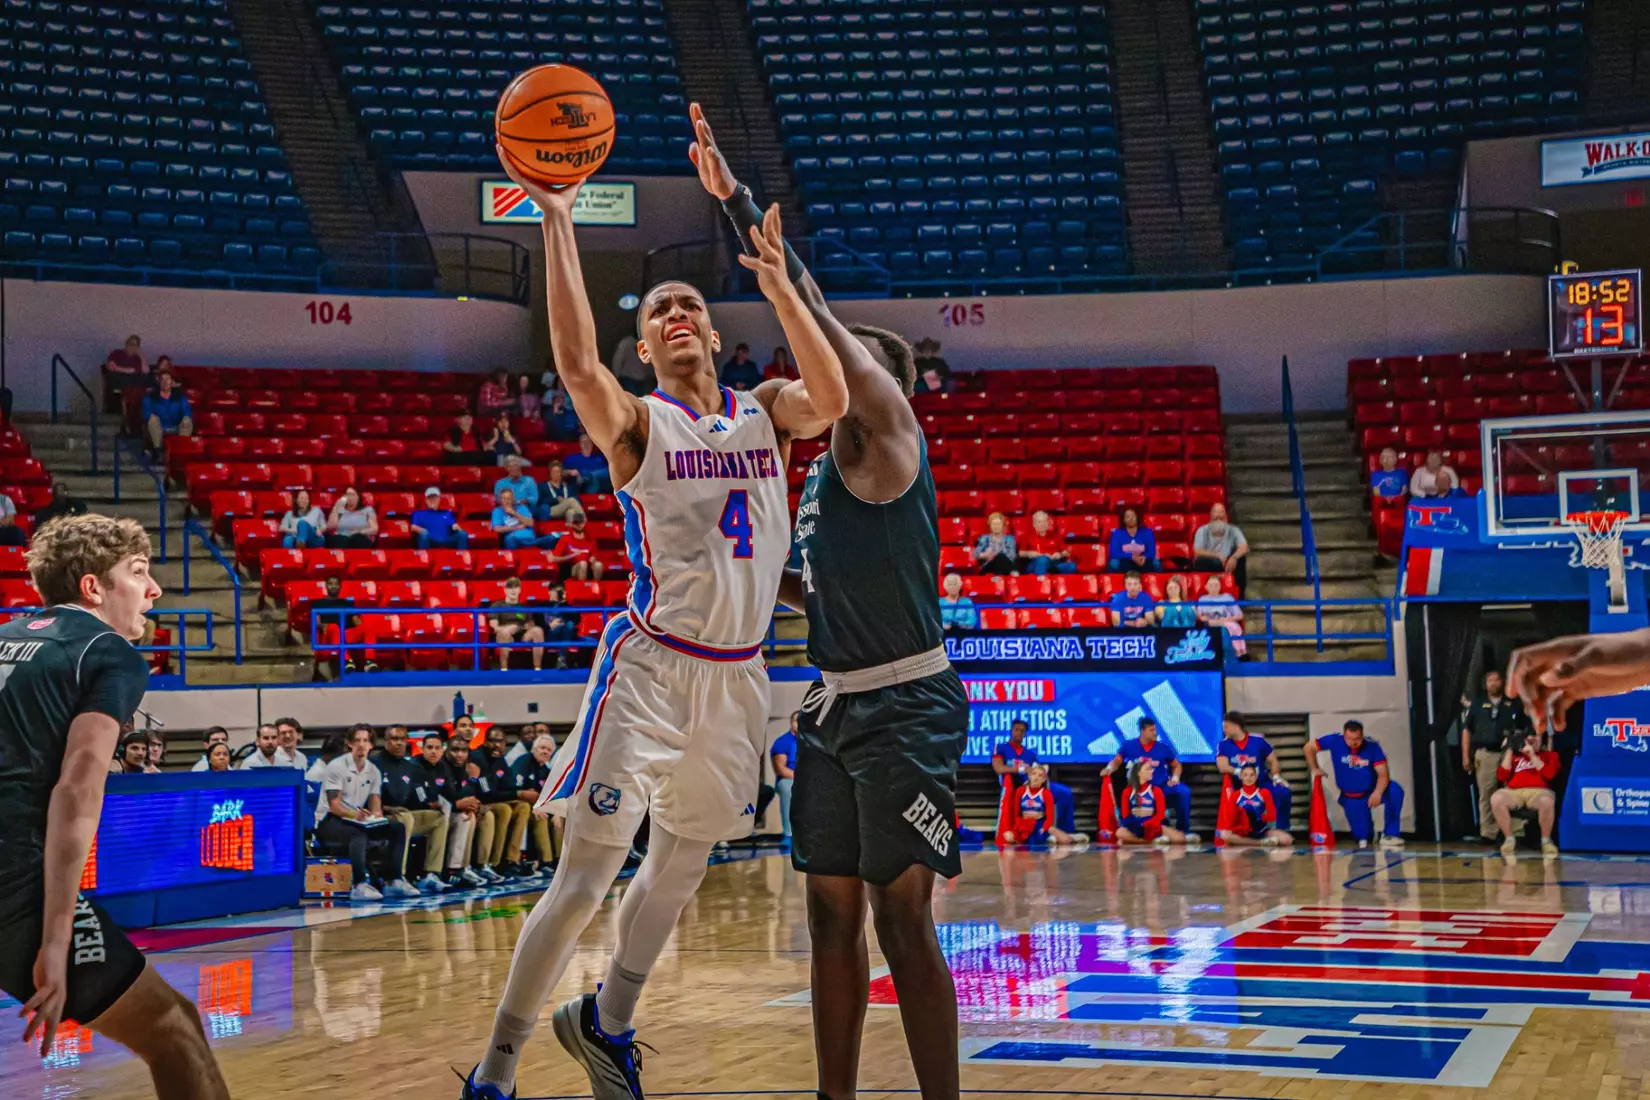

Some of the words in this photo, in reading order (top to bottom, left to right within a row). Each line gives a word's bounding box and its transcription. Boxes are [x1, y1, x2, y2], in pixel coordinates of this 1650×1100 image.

[536, 141, 608, 168] Wilson
[1568, 279, 1630, 305] 18:52
[305, 301, 352, 325] 104
[939, 304, 985, 328] 105
[1585, 304, 1624, 345] 13
[664, 449, 749, 481] LOUISIANA
[718, 489, 753, 559] 4
[945, 637, 1084, 660] LOUISIANA
[1086, 636, 1156, 659] TECH
[1003, 681, 1044, 701] YOU
[902, 792, 953, 857] BEARS
[74, 892, 105, 965] BEAR
